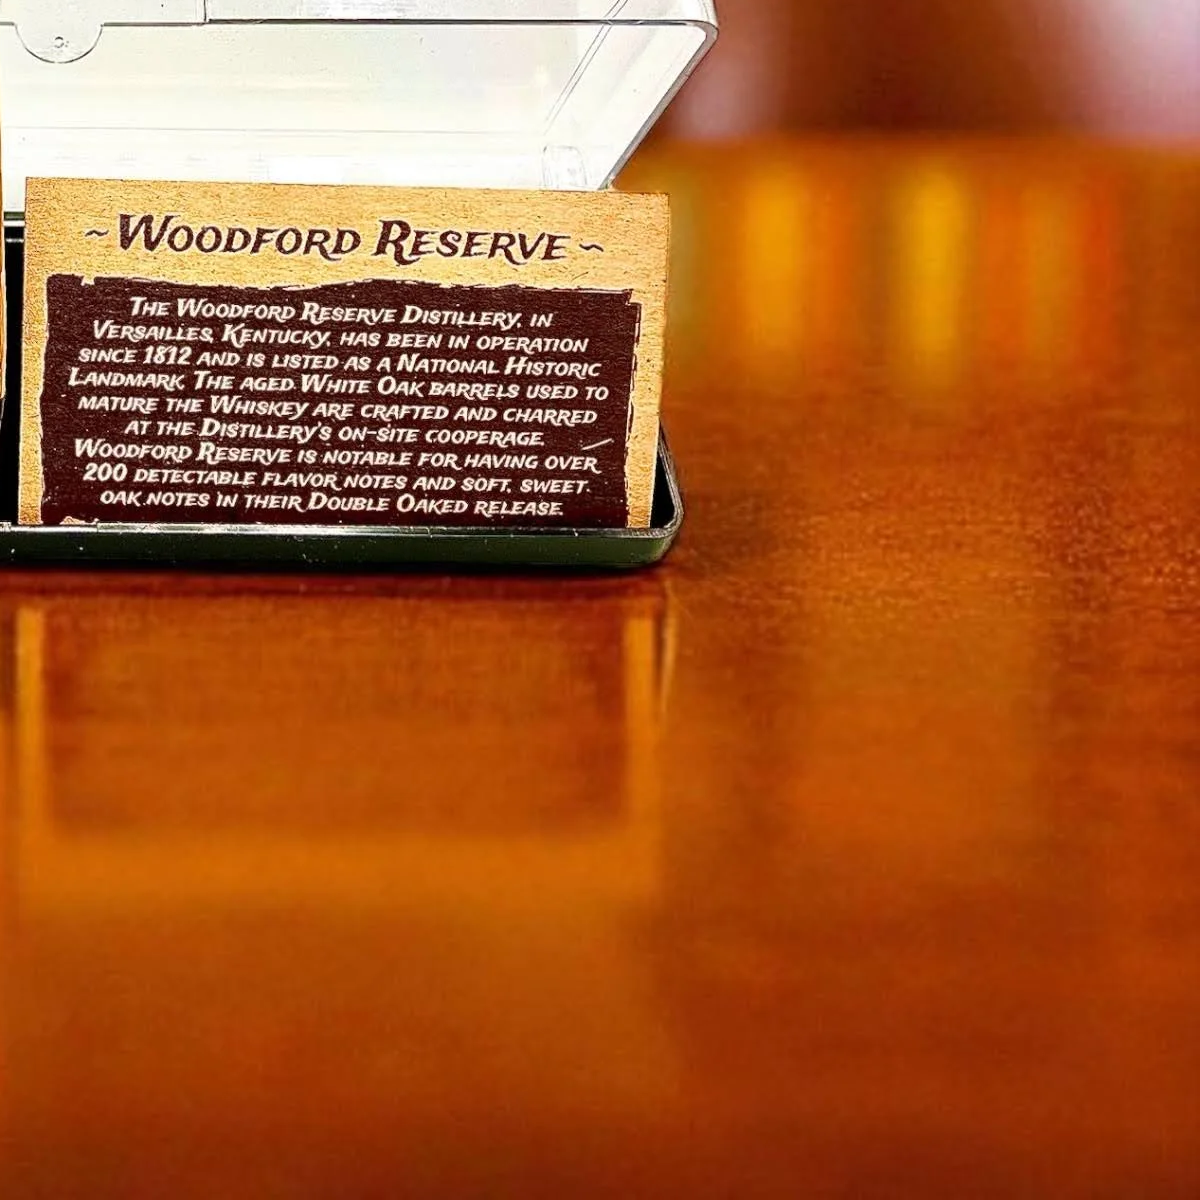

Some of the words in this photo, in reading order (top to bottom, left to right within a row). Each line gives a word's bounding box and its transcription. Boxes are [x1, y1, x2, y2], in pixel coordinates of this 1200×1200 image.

[117, 213, 362, 261] WOODFORD
[374, 220, 571, 265] RESERVE
[339, 332, 381, 347] HAS
[386, 333, 443, 348] BEEN
[448, 335, 470, 349] IN
[476, 336, 589, 355] OPERATION
[78, 347, 137, 364] SINCE
[143, 345, 192, 365] 1812
[197, 351, 241, 367] AND
[246, 353, 265, 368] IS
[272, 353, 339, 370] LISTED
[376, 357, 391, 372] A
[429, 382, 519, 400] BARRELS
[526, 384, 578, 400] USED
[585, 386, 609, 400] TO
[77, 396, 159, 414] MATURE
[166, 398, 205, 413] THE
[312, 402, 354, 420] ARE
[360, 403, 449, 422] CRAFTED
[453, 406, 498, 422] AND
[503, 408, 598, 426] CHARRED
[124, 420, 152, 435] AT
[156, 421, 196, 436] THE
[338, 426, 420, 443] ON-SITE
[297, 450, 317, 464] IS
[322, 451, 413, 466] NOTABLE
[418, 452, 463, 470] FOR
[464, 454, 539, 469] HAVING
[544, 455, 602, 474] OVER
[83, 463, 128, 482] 200
[133, 468, 257, 485] DETECTABLE
[261, 472, 342, 491] FLAVOR
[343, 474, 408, 490] NOTES
[413, 476, 456, 491] AND
[216, 491, 239, 507] IN
[244, 494, 307, 512] THEIR
